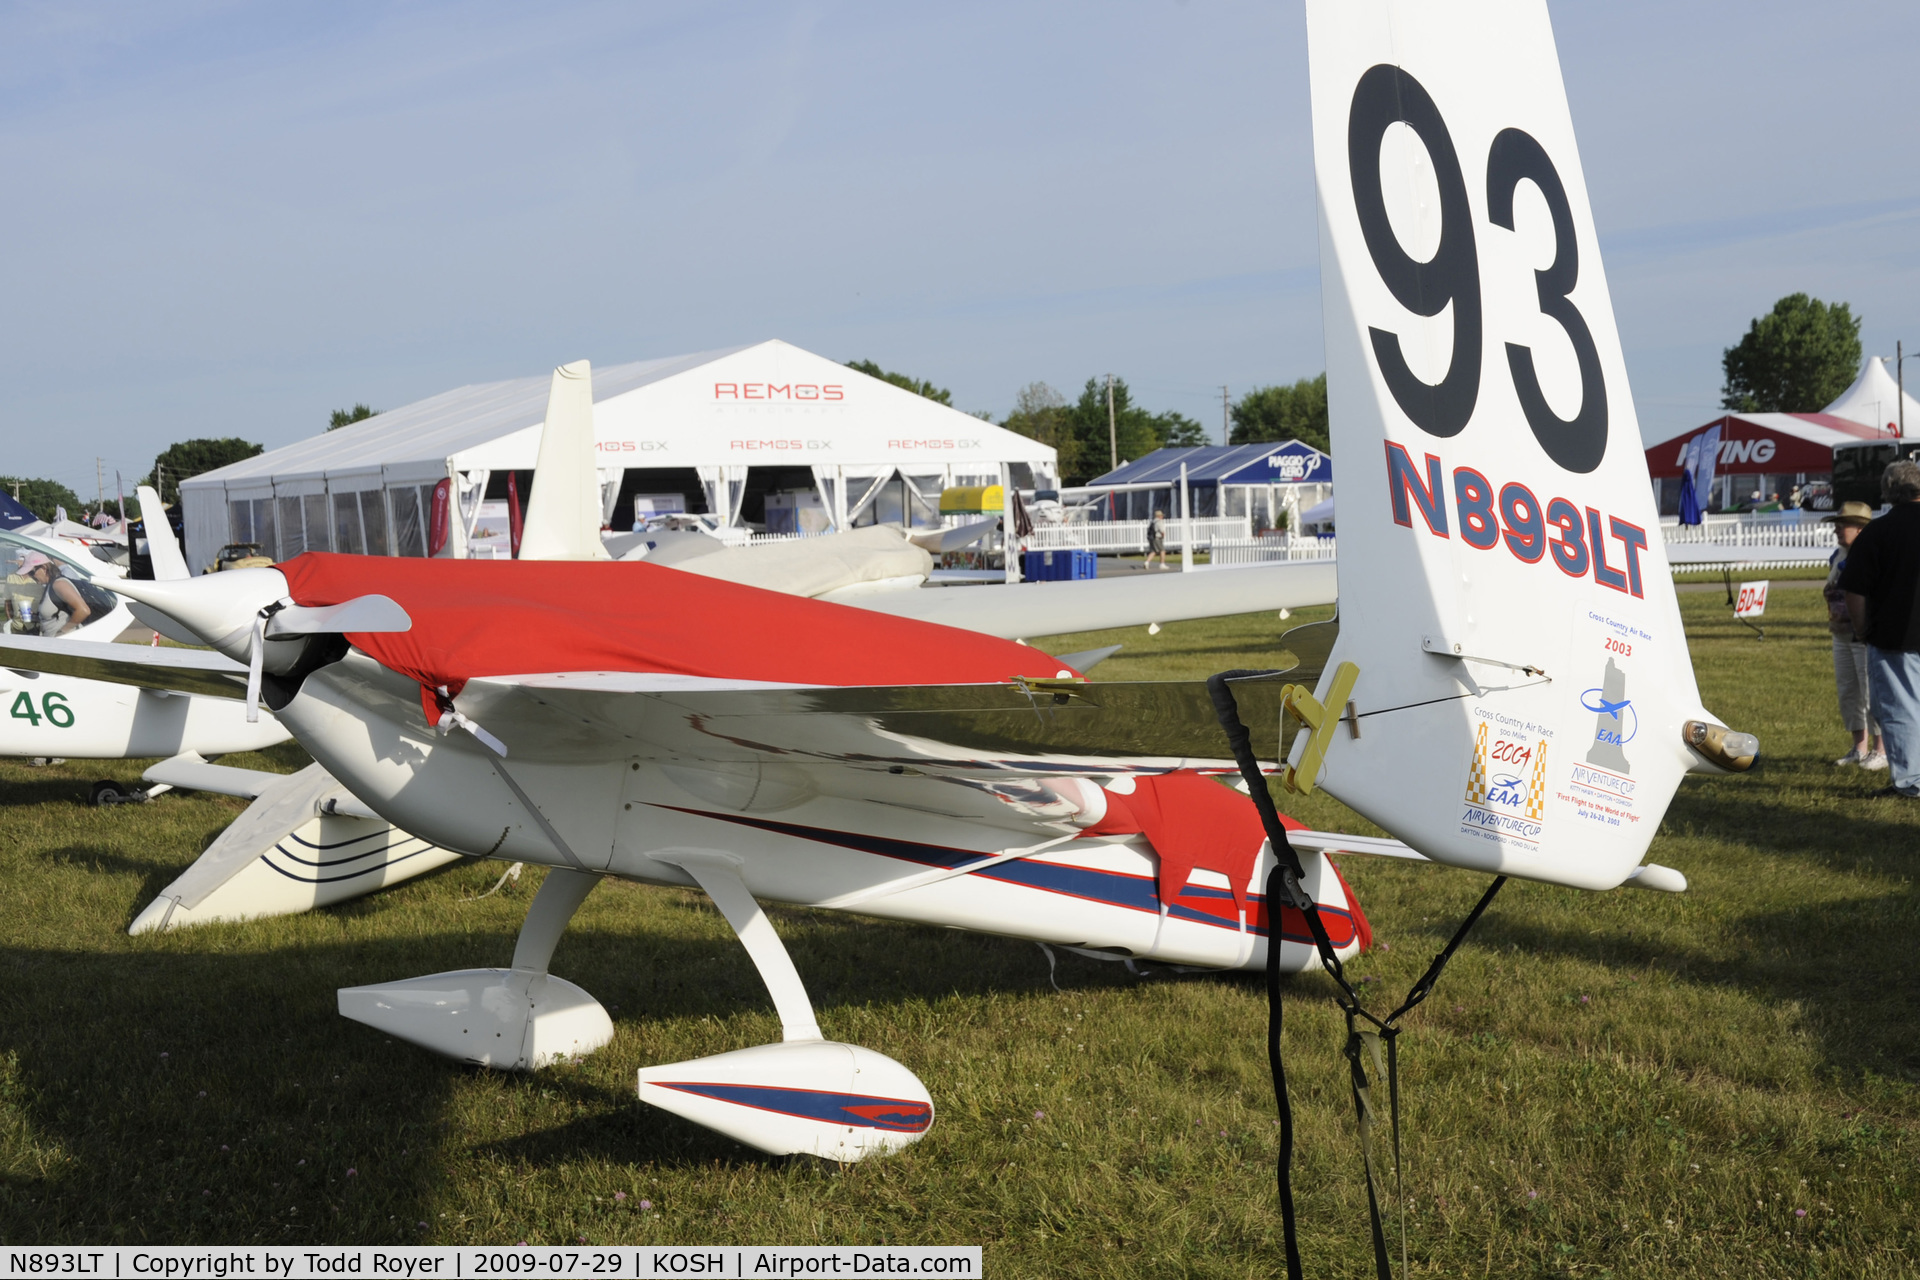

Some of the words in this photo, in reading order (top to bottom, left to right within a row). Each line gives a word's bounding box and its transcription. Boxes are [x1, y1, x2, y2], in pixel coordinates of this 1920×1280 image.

[1348, 63, 1609, 474] 93
[714, 383, 844, 401] REMOS
[641, 441, 669, 451] GX
[731, 440, 802, 450] REMOS
[807, 440, 833, 450] GX
[888, 440, 954, 449] REMOS
[958, 440, 982, 448] GX
[1268, 455, 1304, 468] PIAGGIO
[1280, 466, 1304, 478] AERO
[1383, 438, 1648, 600] N893LT
[1736, 586, 1766, 613] BD-4
[1588, 611, 1605, 623] Cross
[1605, 617, 1628, 634] Country
[1629, 626, 1638, 635] Air
[1639, 630, 1652, 641] Race
[1604, 637, 1632, 657] 2003
[10, 691, 75, 728] 46
[1474, 706, 1494, 720] Cross
[1495, 713, 1524, 731] Country
[1525, 722, 1536, 732] Air
[1537, 725, 1554, 738] Race
[1499, 728, 1511, 737] 500
[1512, 730, 1527, 742] Miles
[1596, 728, 1622, 746] EAA
[1486, 787, 1520, 807] EAA
[1571, 796, 1587, 807] Flight
[1588, 801, 1594, 809] to
[1595, 802, 1604, 811] the
[1604, 806, 1620, 816] World
[1577, 808, 1588, 819] July
[1460, 827, 1480, 837] DAYTON
[1483, 833, 1507, 844] ROCKFORD
[1510, 840, 1524, 848] FOND
